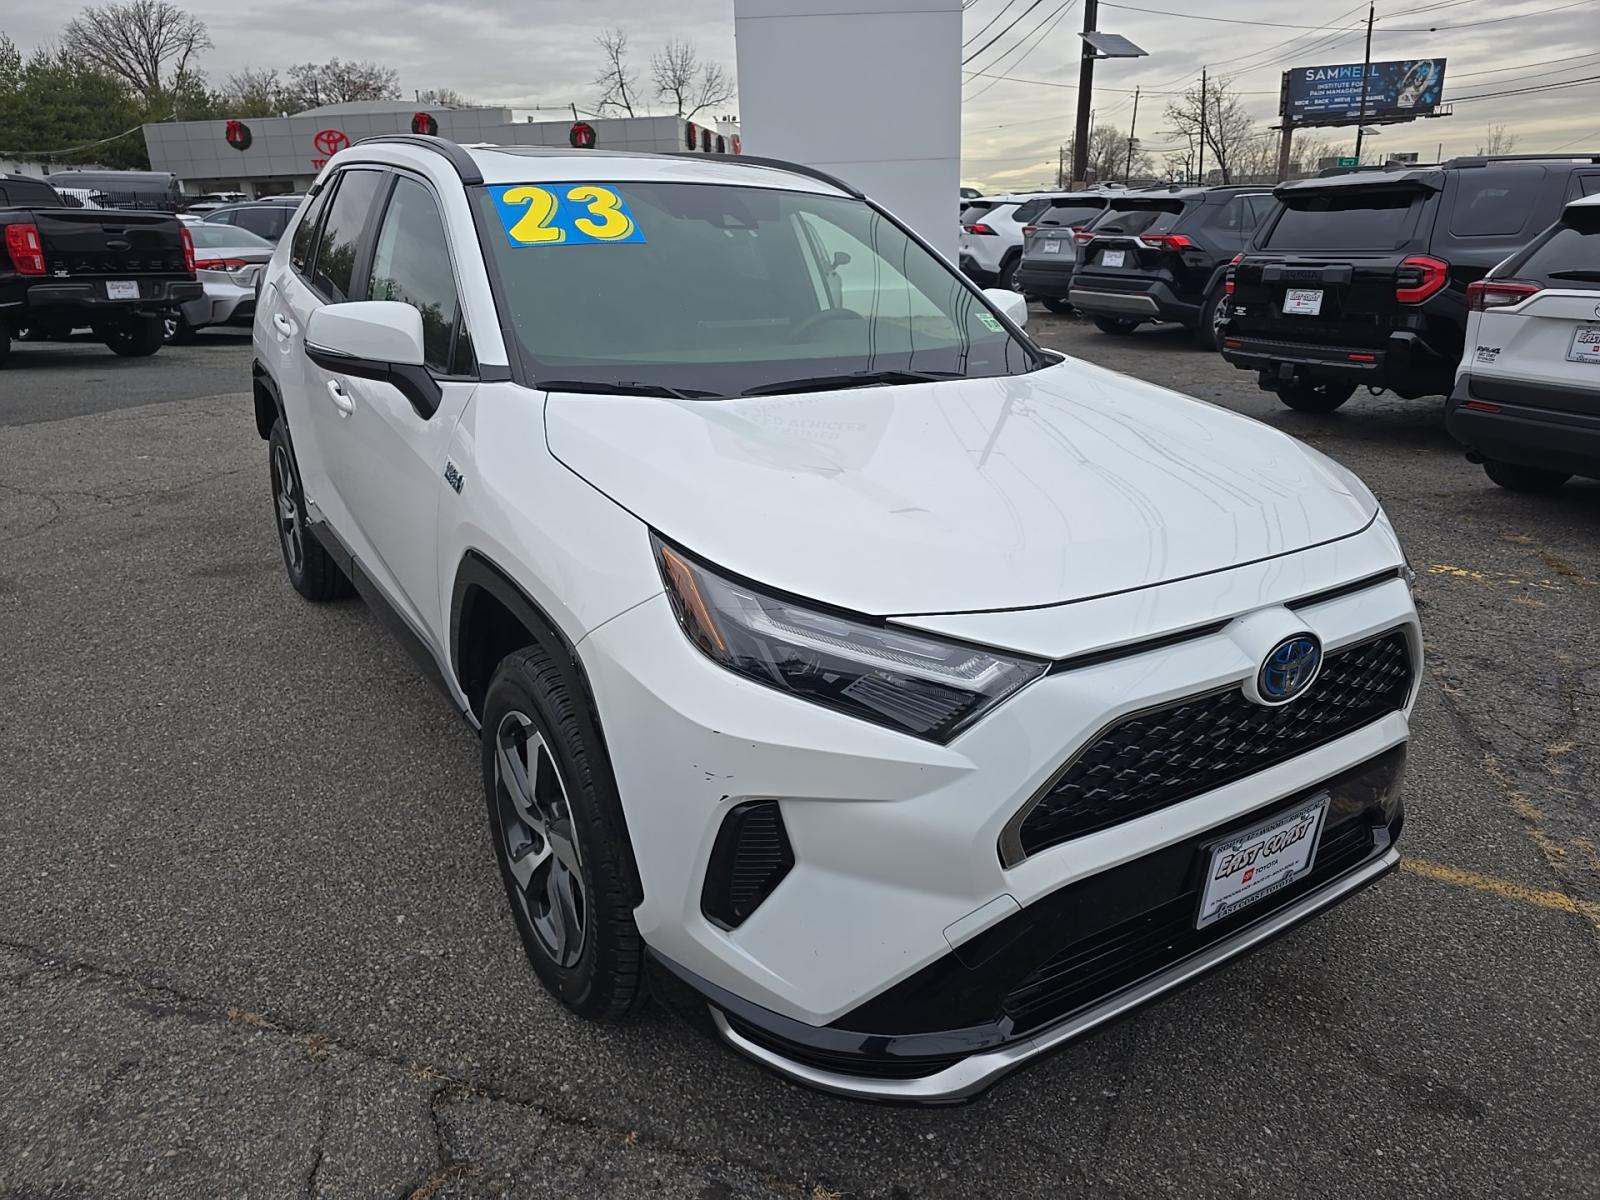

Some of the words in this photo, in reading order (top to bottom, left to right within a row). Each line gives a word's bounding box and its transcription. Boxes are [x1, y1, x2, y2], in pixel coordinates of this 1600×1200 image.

[1305, 66, 1379, 80] SAMWELL
[1317, 82, 1350, 90] INSTITUTE
[1326, 87, 1372, 95] MANAGEMET
[502, 186, 635, 243] 23
[1215, 841, 1265, 880] EAST
[1263, 815, 1315, 857] COAST
[1255, 859, 1279, 874] TOYOTA
[1218, 904, 1237, 919] EAST
[1239, 893, 1263, 907] COAST
[1266, 878, 1294, 893] TOYOTA
